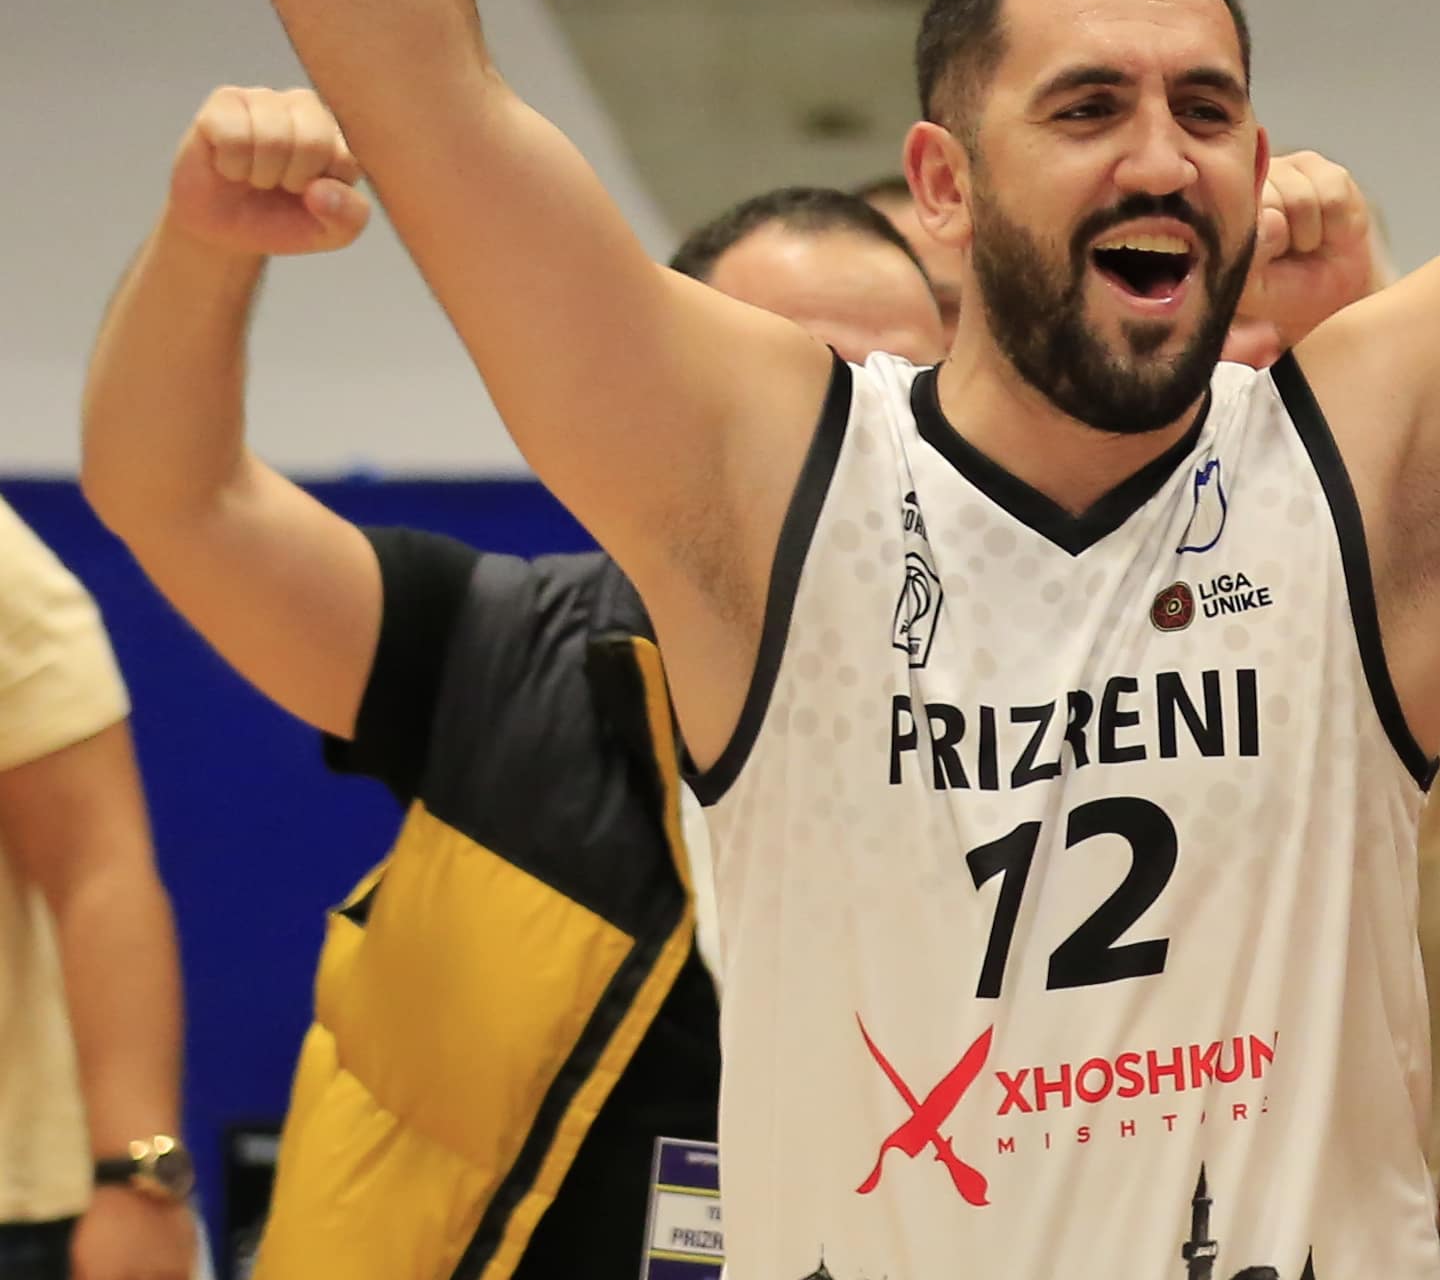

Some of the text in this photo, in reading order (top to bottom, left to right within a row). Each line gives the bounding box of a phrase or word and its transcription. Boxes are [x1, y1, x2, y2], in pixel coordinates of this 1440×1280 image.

[1199, 572, 1252, 601] LIGA
[1202, 587, 1274, 619] UNIKE
[889, 668, 1260, 791] PRIZRENI
[965, 794, 1182, 999] 12
[994, 1030, 1279, 1117] XHOSHKUN
